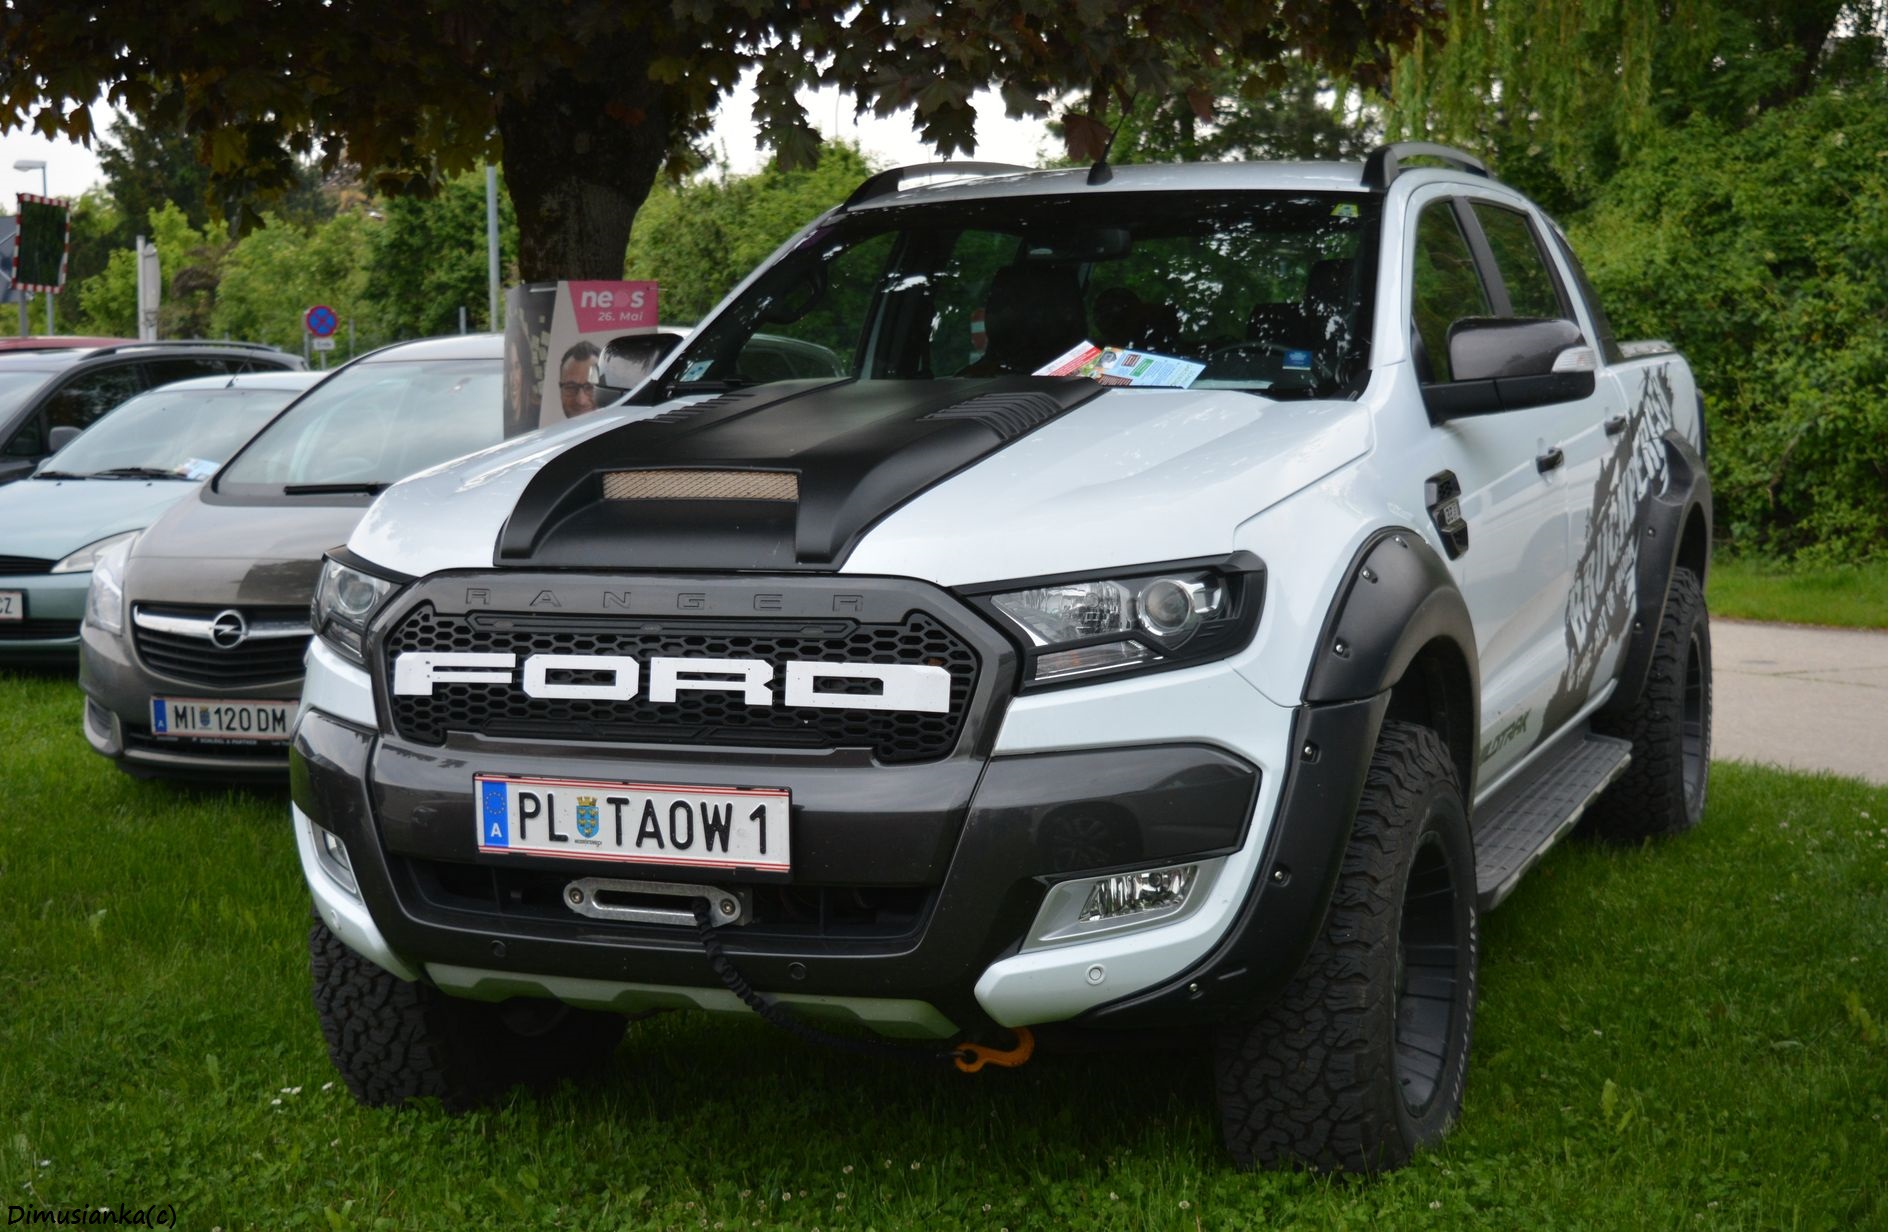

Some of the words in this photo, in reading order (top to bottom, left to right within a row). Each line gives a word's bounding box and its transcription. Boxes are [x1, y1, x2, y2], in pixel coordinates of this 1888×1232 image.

[598, 311, 616, 322] 26.
[619, 311, 644, 322] Mai
[465, 587, 864, 613] RANGER
[393, 652, 951, 713] FORD
[173, 704, 196, 730] MI
[213, 706, 252, 732] 120
[256, 707, 287, 733] DM
[490, 821, 504, 839] A
[517, 790, 570, 842] PL
[605, 796, 734, 854] TAOW
[748, 803, 768, 855] 1
